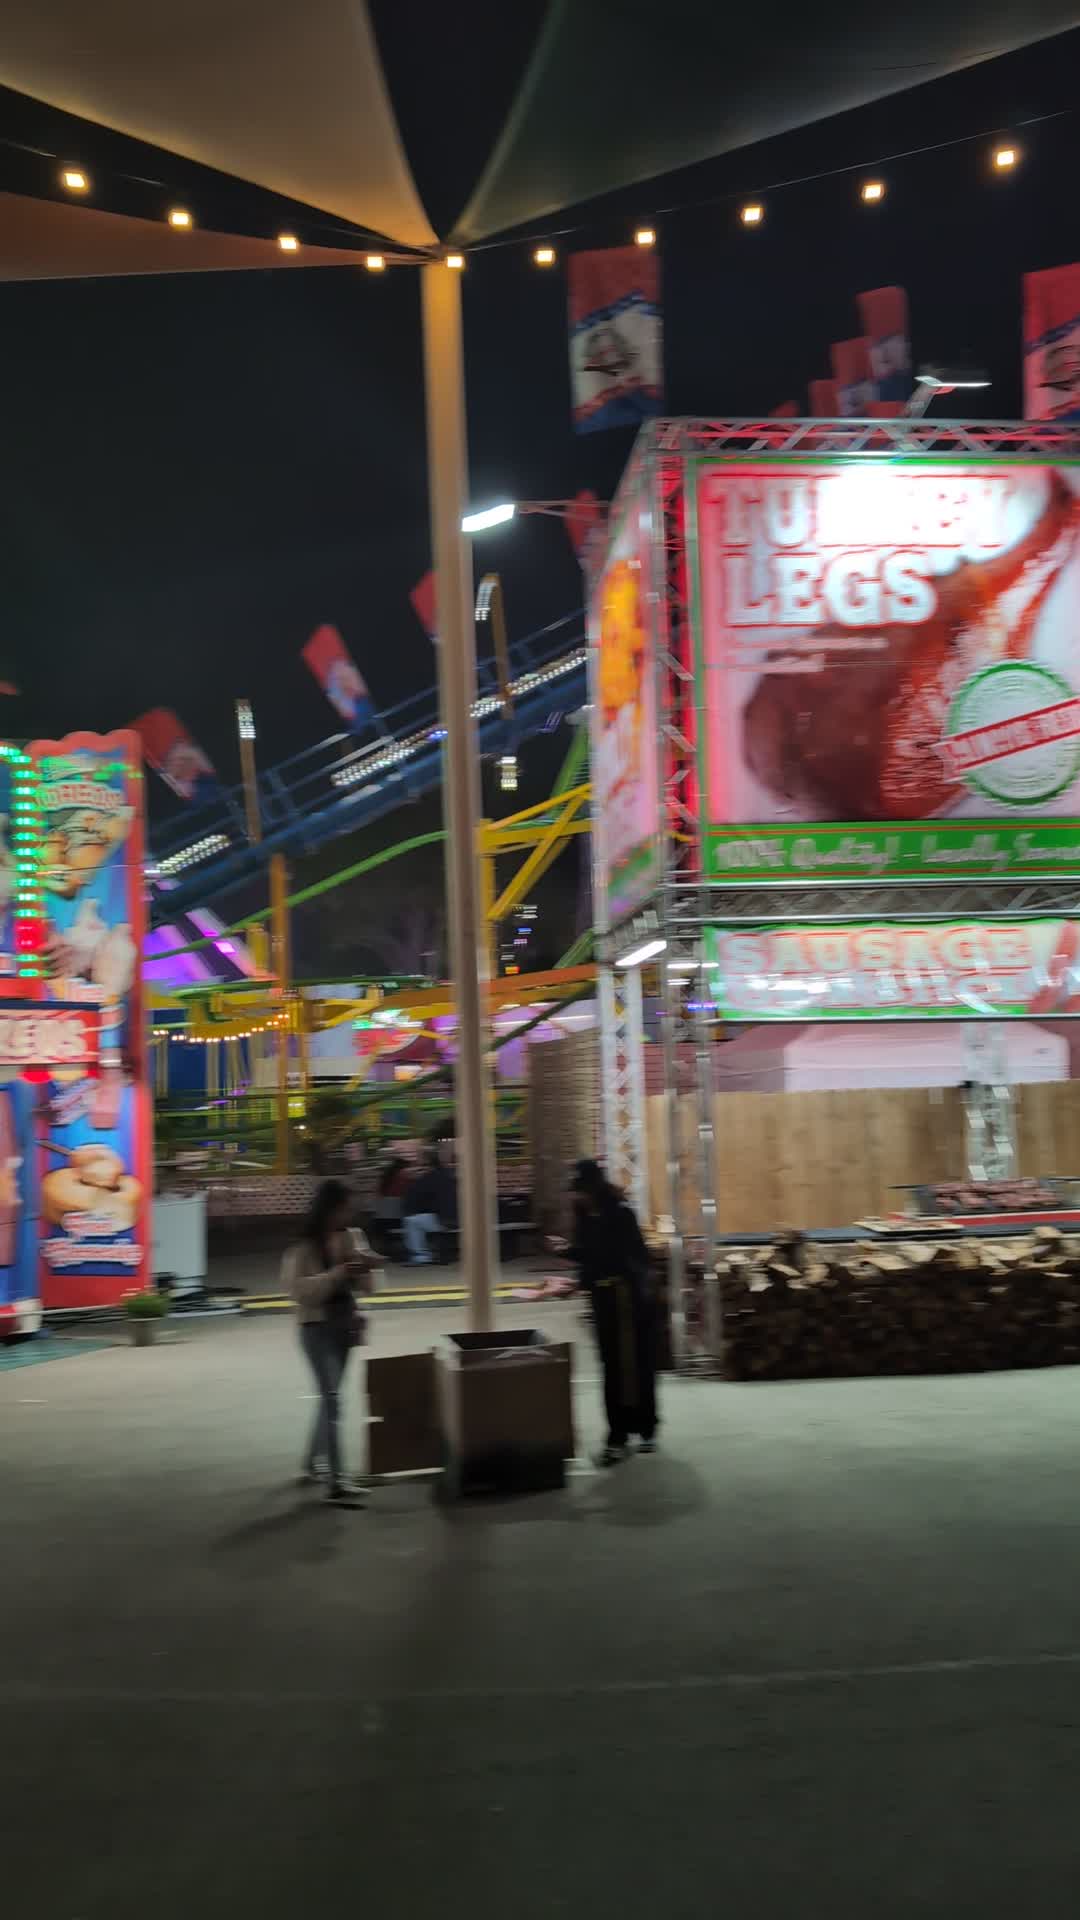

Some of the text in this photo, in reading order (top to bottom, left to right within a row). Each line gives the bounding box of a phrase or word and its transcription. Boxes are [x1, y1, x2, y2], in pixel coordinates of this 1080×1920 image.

[706, 474, 1010, 548] TUEY
[720, 551, 938, 628] LEGS
[720, 928, 1033, 975] SAUSAGE
